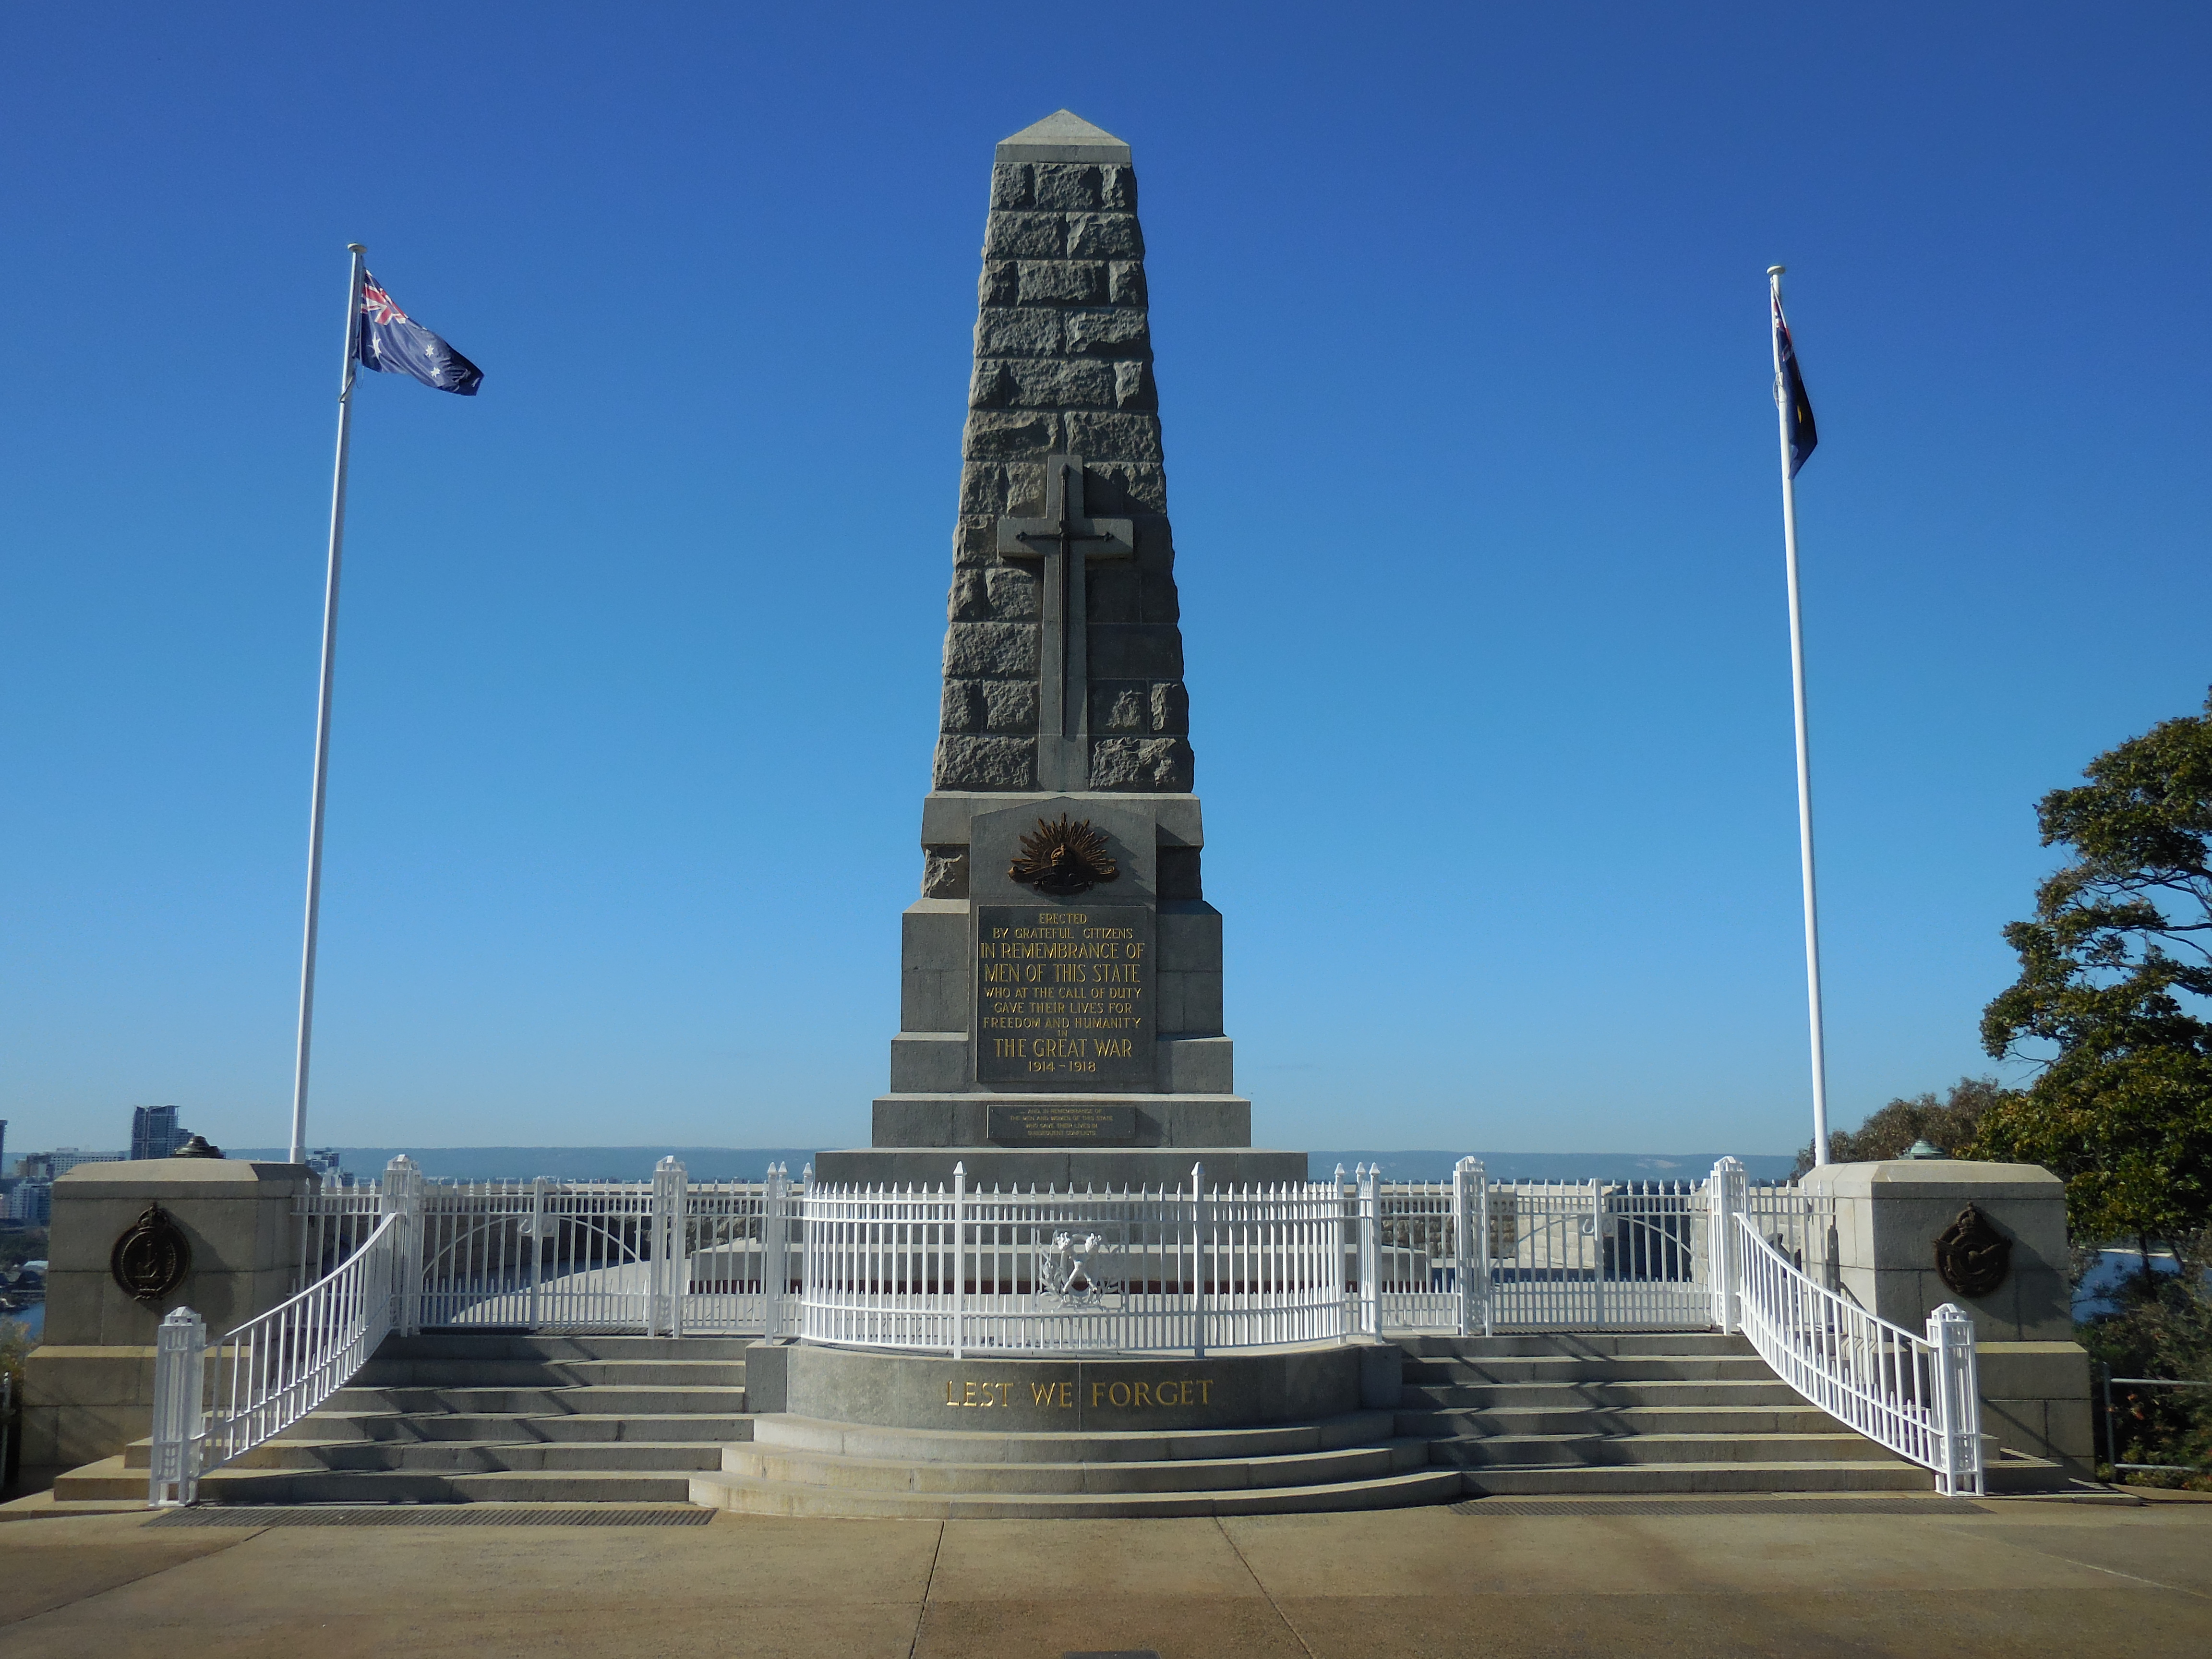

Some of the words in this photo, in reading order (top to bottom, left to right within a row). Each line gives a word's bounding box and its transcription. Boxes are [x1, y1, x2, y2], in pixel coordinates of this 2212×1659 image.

[1039, 913, 1087, 924] ERECTED
[993, 928, 1009, 939] BY
[1014, 928, 1074, 939] GRATEFUL
[1083, 928, 1133, 939] CITIZENS
[980, 943, 995, 959] IN
[1001, 943, 1119, 959] REMEMBRANCE
[1126, 943, 1145, 959] OF
[985, 964, 1020, 982] MEN
[1025, 964, 1048, 982] OF
[1053, 964, 1086, 982] THIS
[1093, 964, 1141, 982] STATE
[984, 987, 1010, 998] WHO
[1015, 987, 1028, 998] AT
[1034, 987, 1054, 998] THE
[1059, 987, 1086, 998] CALL
[1091, 987, 1105, 998] OF
[1109, 987, 1142, 998] DUTY
[994, 1002, 1024, 1013] GAVE
[1030, 1002, 1065, 1013] THEIR
[1070, 1002, 1103, 1013] LIVES
[1109, 1002, 1132, 1013] FOR
[983, 1017, 1040, 1028] FREEDOM
[1045, 1017, 1070, 1028] AND
[1075, 1017, 1142, 1028] HUMANITY
[993, 1039, 1027, 1058] THE
[1033, 1039, 1087, 1058] GREAT
[1094, 1039, 1132, 1058] WAR
[1028, 1061, 1055, 1072] 1914
[1069, 1061, 1096, 1072] 1918
[946, 1380, 1014, 1407] LEST
[1031, 1382, 1073, 1407] WE
[1091, 1379, 1213, 1407] FORGET
